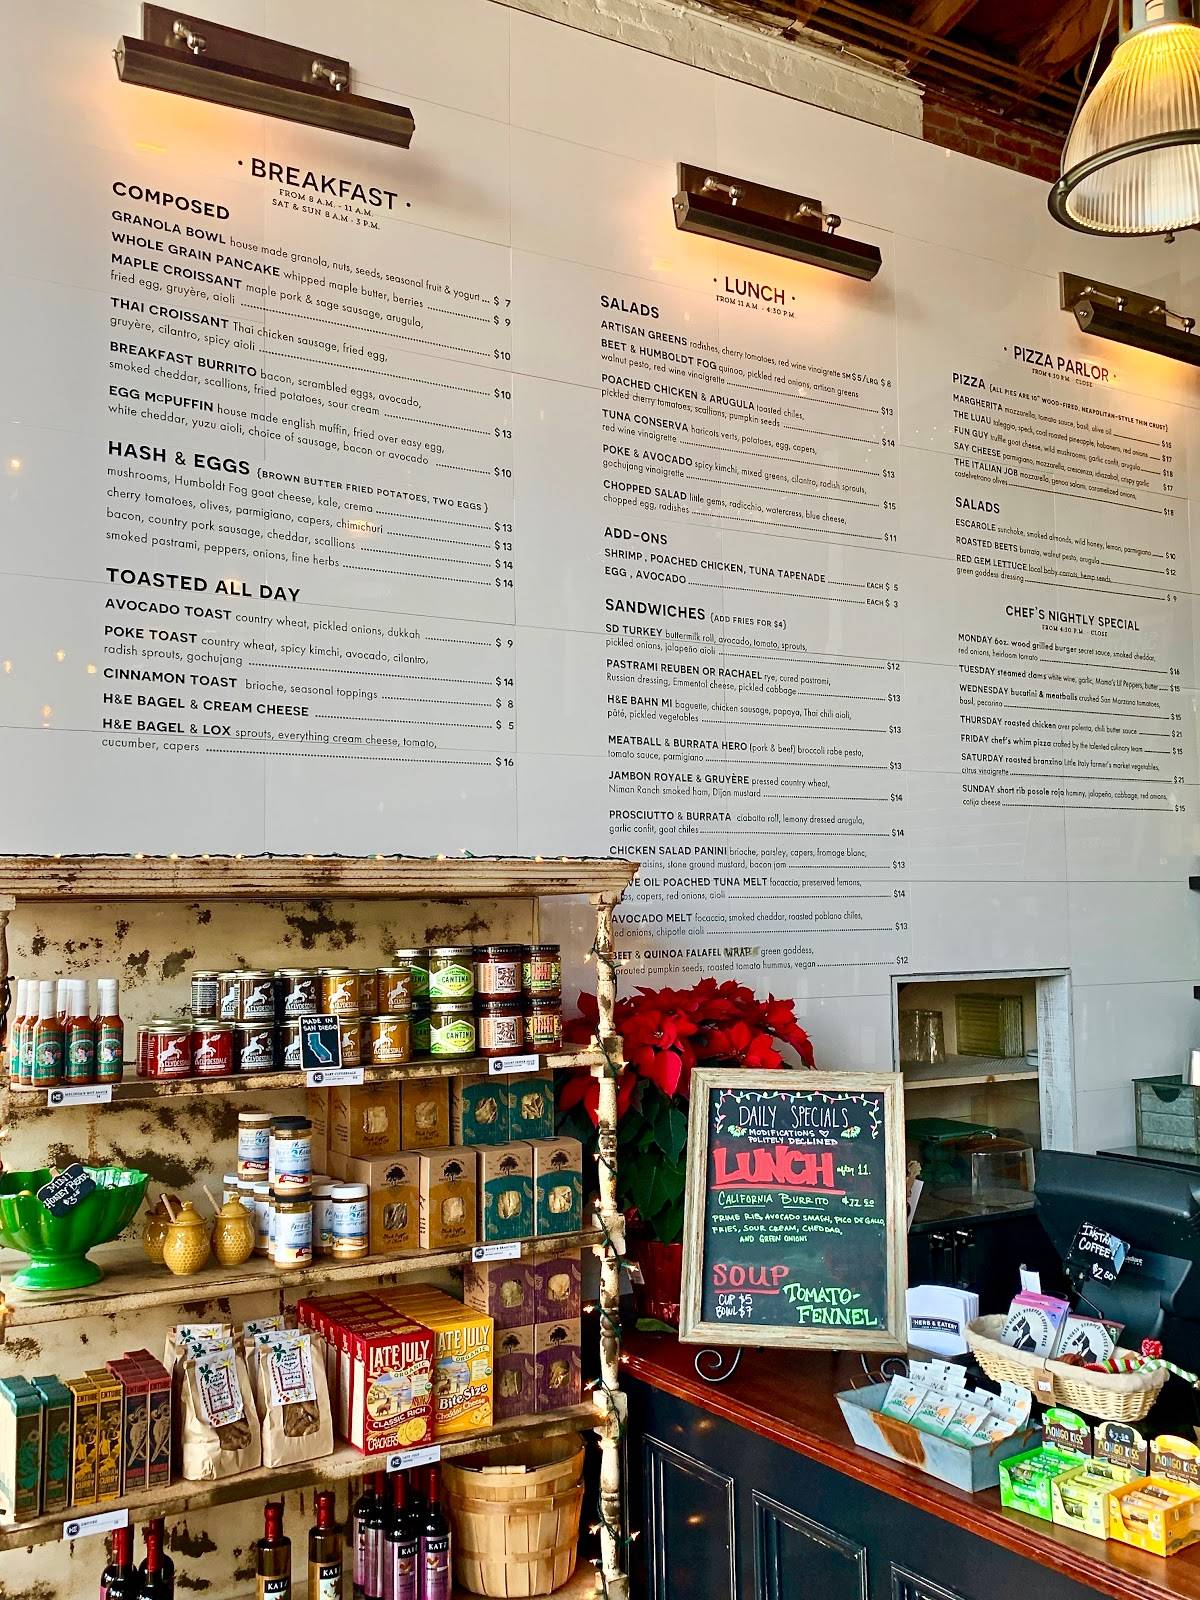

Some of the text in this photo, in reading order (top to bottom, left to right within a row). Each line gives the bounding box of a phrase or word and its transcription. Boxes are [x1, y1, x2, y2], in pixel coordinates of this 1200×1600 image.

[251, 157, 398, 210] BREAKFAST
[112, 181, 230, 220] COMPOSED
[279, 188, 306, 201] FROM
[271, 198, 322, 216] SAT SUN
[111, 231, 280, 277] WHOLE GRAIN PANCAKE
[111, 210, 480, 301] GRANOLA BOWL house made granola, nuts, seeds, seasonal fruit yogurt
[111, 252, 243, 289] MAPLE CROISSANT
[725, 275, 785, 306] LUNCH
[110, 296, 145, 313] THAI
[600, 294, 660, 319] SALADS
[600, 319, 688, 346] ARTISAN GREENS
[601, 338, 717, 370] BEET HUMBOLDT FOG
[197, 356, 257, 377] BURRITO
[1013, 345, 1109, 382] PIZZA PARLOR
[601, 373, 755, 411] POACHED CHICKEN ARUGULA
[880, 406, 894, 416] $13
[952, 393, 1003, 412] MARGHERITA
[601, 408, 689, 433] TUNA CONSERVA
[970, 412, 992, 425] LUAU
[881, 437, 895, 448] $14
[971, 444, 1002, 458] CHEESE
[108, 440, 250, 476] HASH EGGS
[971, 460, 1019, 477] ITALIAN JOB
[345, 483, 430, 504] FRIED POTATOES,
[603, 479, 687, 500] CHOPPED SALAD
[955, 496, 1000, 514] SALADS
[955, 517, 996, 532] ESCAROLE
[603, 526, 668, 545] ADD-ONS
[884, 532, 897, 542] $11
[955, 535, 1018, 553] ROASTED BEETS
[992, 558, 1028, 572] LETTUCE
[105, 567, 301, 602] TOASTED ALL DAY
[104, 598, 232, 621] AVOCADO TOAST
[605, 597, 706, 621] SANDWICHES
[1005, 605, 1140, 631] CHEF'S NIGHTLY SPECIAL
[621, 624, 663, 637] TURKEY
[958, 632, 1077, 655] MONDAY burger
[103, 667, 238, 688] CINNAMON TOAST
[606, 658, 763, 680] PASTRAMI REUBEN OR RACHAEL
[959, 683, 1009, 695] WEDNESDAY
[137, 695, 309, 717] BAGEL CREAM CHEESE
[630, 695, 659, 707] BAHN
[629, 708, 699, 723] pickled vegetables
[959, 714, 1003, 726] THURSDAY
[202, 724, 231, 736] LOX
[960, 733, 989, 743] FRIDAY
[101, 737, 200, 753] cucumber, capers
[608, 734, 748, 751] MEATBALL BURRATA HERO
[608, 770, 750, 785] JAMBON ROYALE GRUYÈRE
[962, 784, 995, 793] SUNDAY
[609, 809, 675, 821] PROSCIUTTO
[643, 947, 722, 960] QUINOA FALAFEL
[738, 1105, 850, 1129] DAILY SPECIALS
[747, 1136, 839, 1146] POLITELY DECLINED
[748, 1129, 816, 1138] MODIFICATIONS
[713, 1145, 836, 1188] LUNCH
[43, 1187, 70, 1209] HONEY
[718, 1191, 829, 1206] CALIFORNIA BURRITO
[711, 1213, 741, 1222] PRIME
[765, 1213, 800, 1222] AVOCADO
[834, 1215, 852, 1224] PICO
[854, 1216, 864, 1224] DE
[711, 1224, 843, 1236] FRIES, SOUR CREAM, CHEDDAR,
[739, 1234, 808, 1243] AND GREEN ONIONS
[1081, 1224, 1123, 1248] INSTANT
[1078, 1236, 1116, 1261] COFFEE!
[712, 1263, 791, 1287] SOUP
[718, 1294, 736, 1307] CUP
[782, 1282, 861, 1306] TOMATO-
[795, 1304, 878, 1327] FENNEL
[937, 1321, 958, 1329] EATERY
[461, 1324, 490, 1357] JULY
[369, 1340, 430, 1377] LATE JULY
[455, 1346, 487, 1362] ORGANIC
[393, 1361, 427, 1378] ORGANIC
[372, 1406, 428, 1429] CLASSIC RICH
[367, 1436, 400, 1451] CRACKERS
[1070, 1431, 1084, 1445] KISS
[1125, 1446, 1139, 1460] KISS
